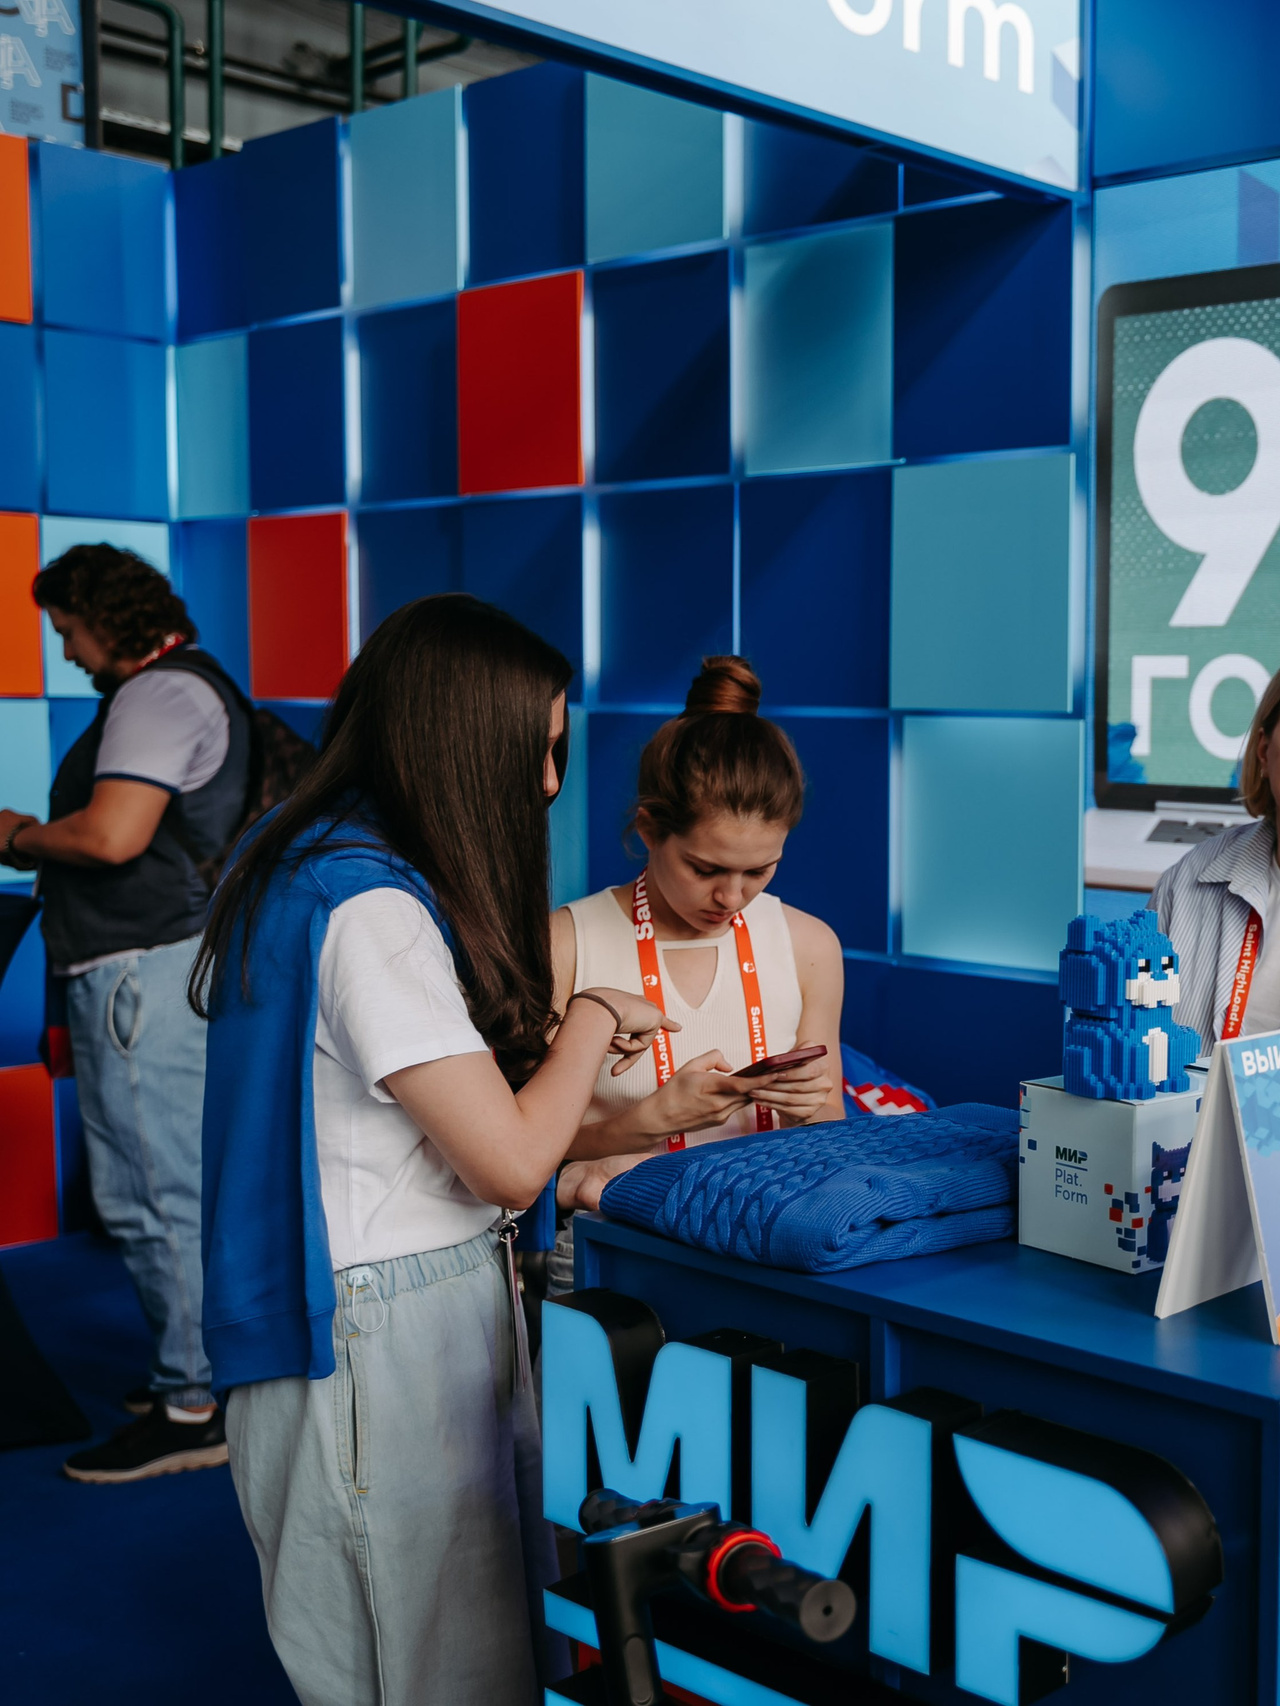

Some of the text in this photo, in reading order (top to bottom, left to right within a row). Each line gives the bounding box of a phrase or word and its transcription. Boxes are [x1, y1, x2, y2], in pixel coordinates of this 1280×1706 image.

[825, 0, 1034, 94] orm
[1243, 923, 1258, 957] Saint
[750, 1006, 762, 1044] Saint
[1055, 1145, 1088, 1165] МИР
[1055, 1167, 1083, 1188] Plat.
[1055, 1184, 1088, 1206] Form
[542, 1300, 1175, 1706] МИР
